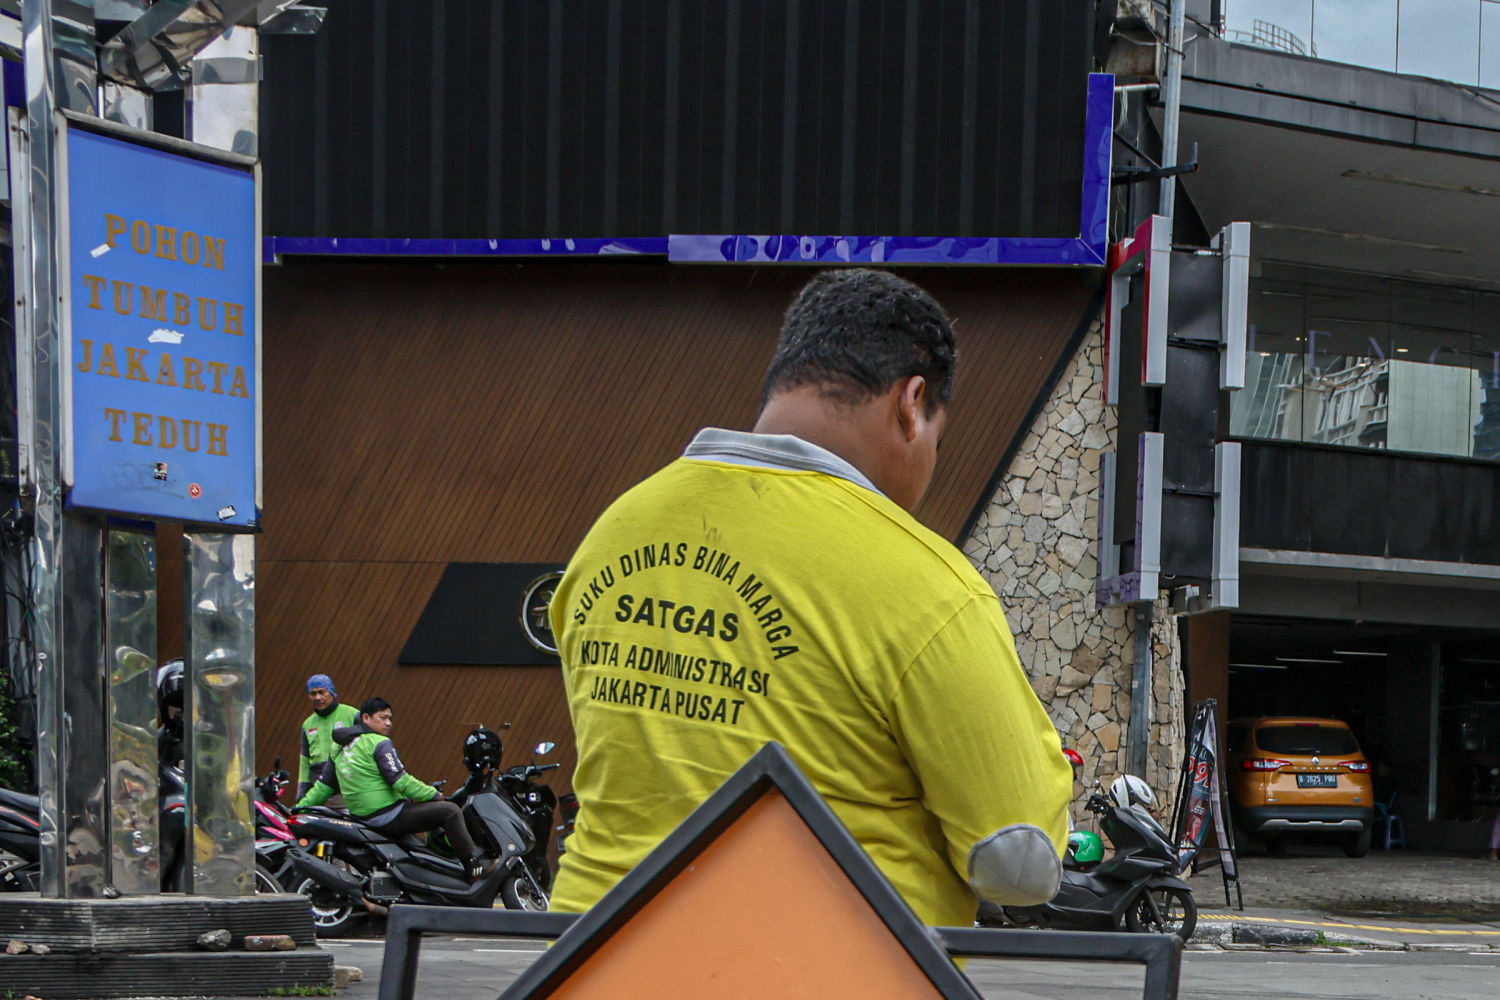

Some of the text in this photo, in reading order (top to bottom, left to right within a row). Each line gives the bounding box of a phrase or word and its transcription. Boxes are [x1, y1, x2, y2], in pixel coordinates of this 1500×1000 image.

[104, 213, 226, 271] POHON
[83, 274, 245, 336] TUMBUH
[77, 338, 250, 399] JAKARTA
[104, 407, 229, 457] TEDUH
[574, 542, 799, 660] SUKU DINAS BINA MARGA
[615, 594, 739, 642] SATGAS
[581, 640, 619, 667] KOTA
